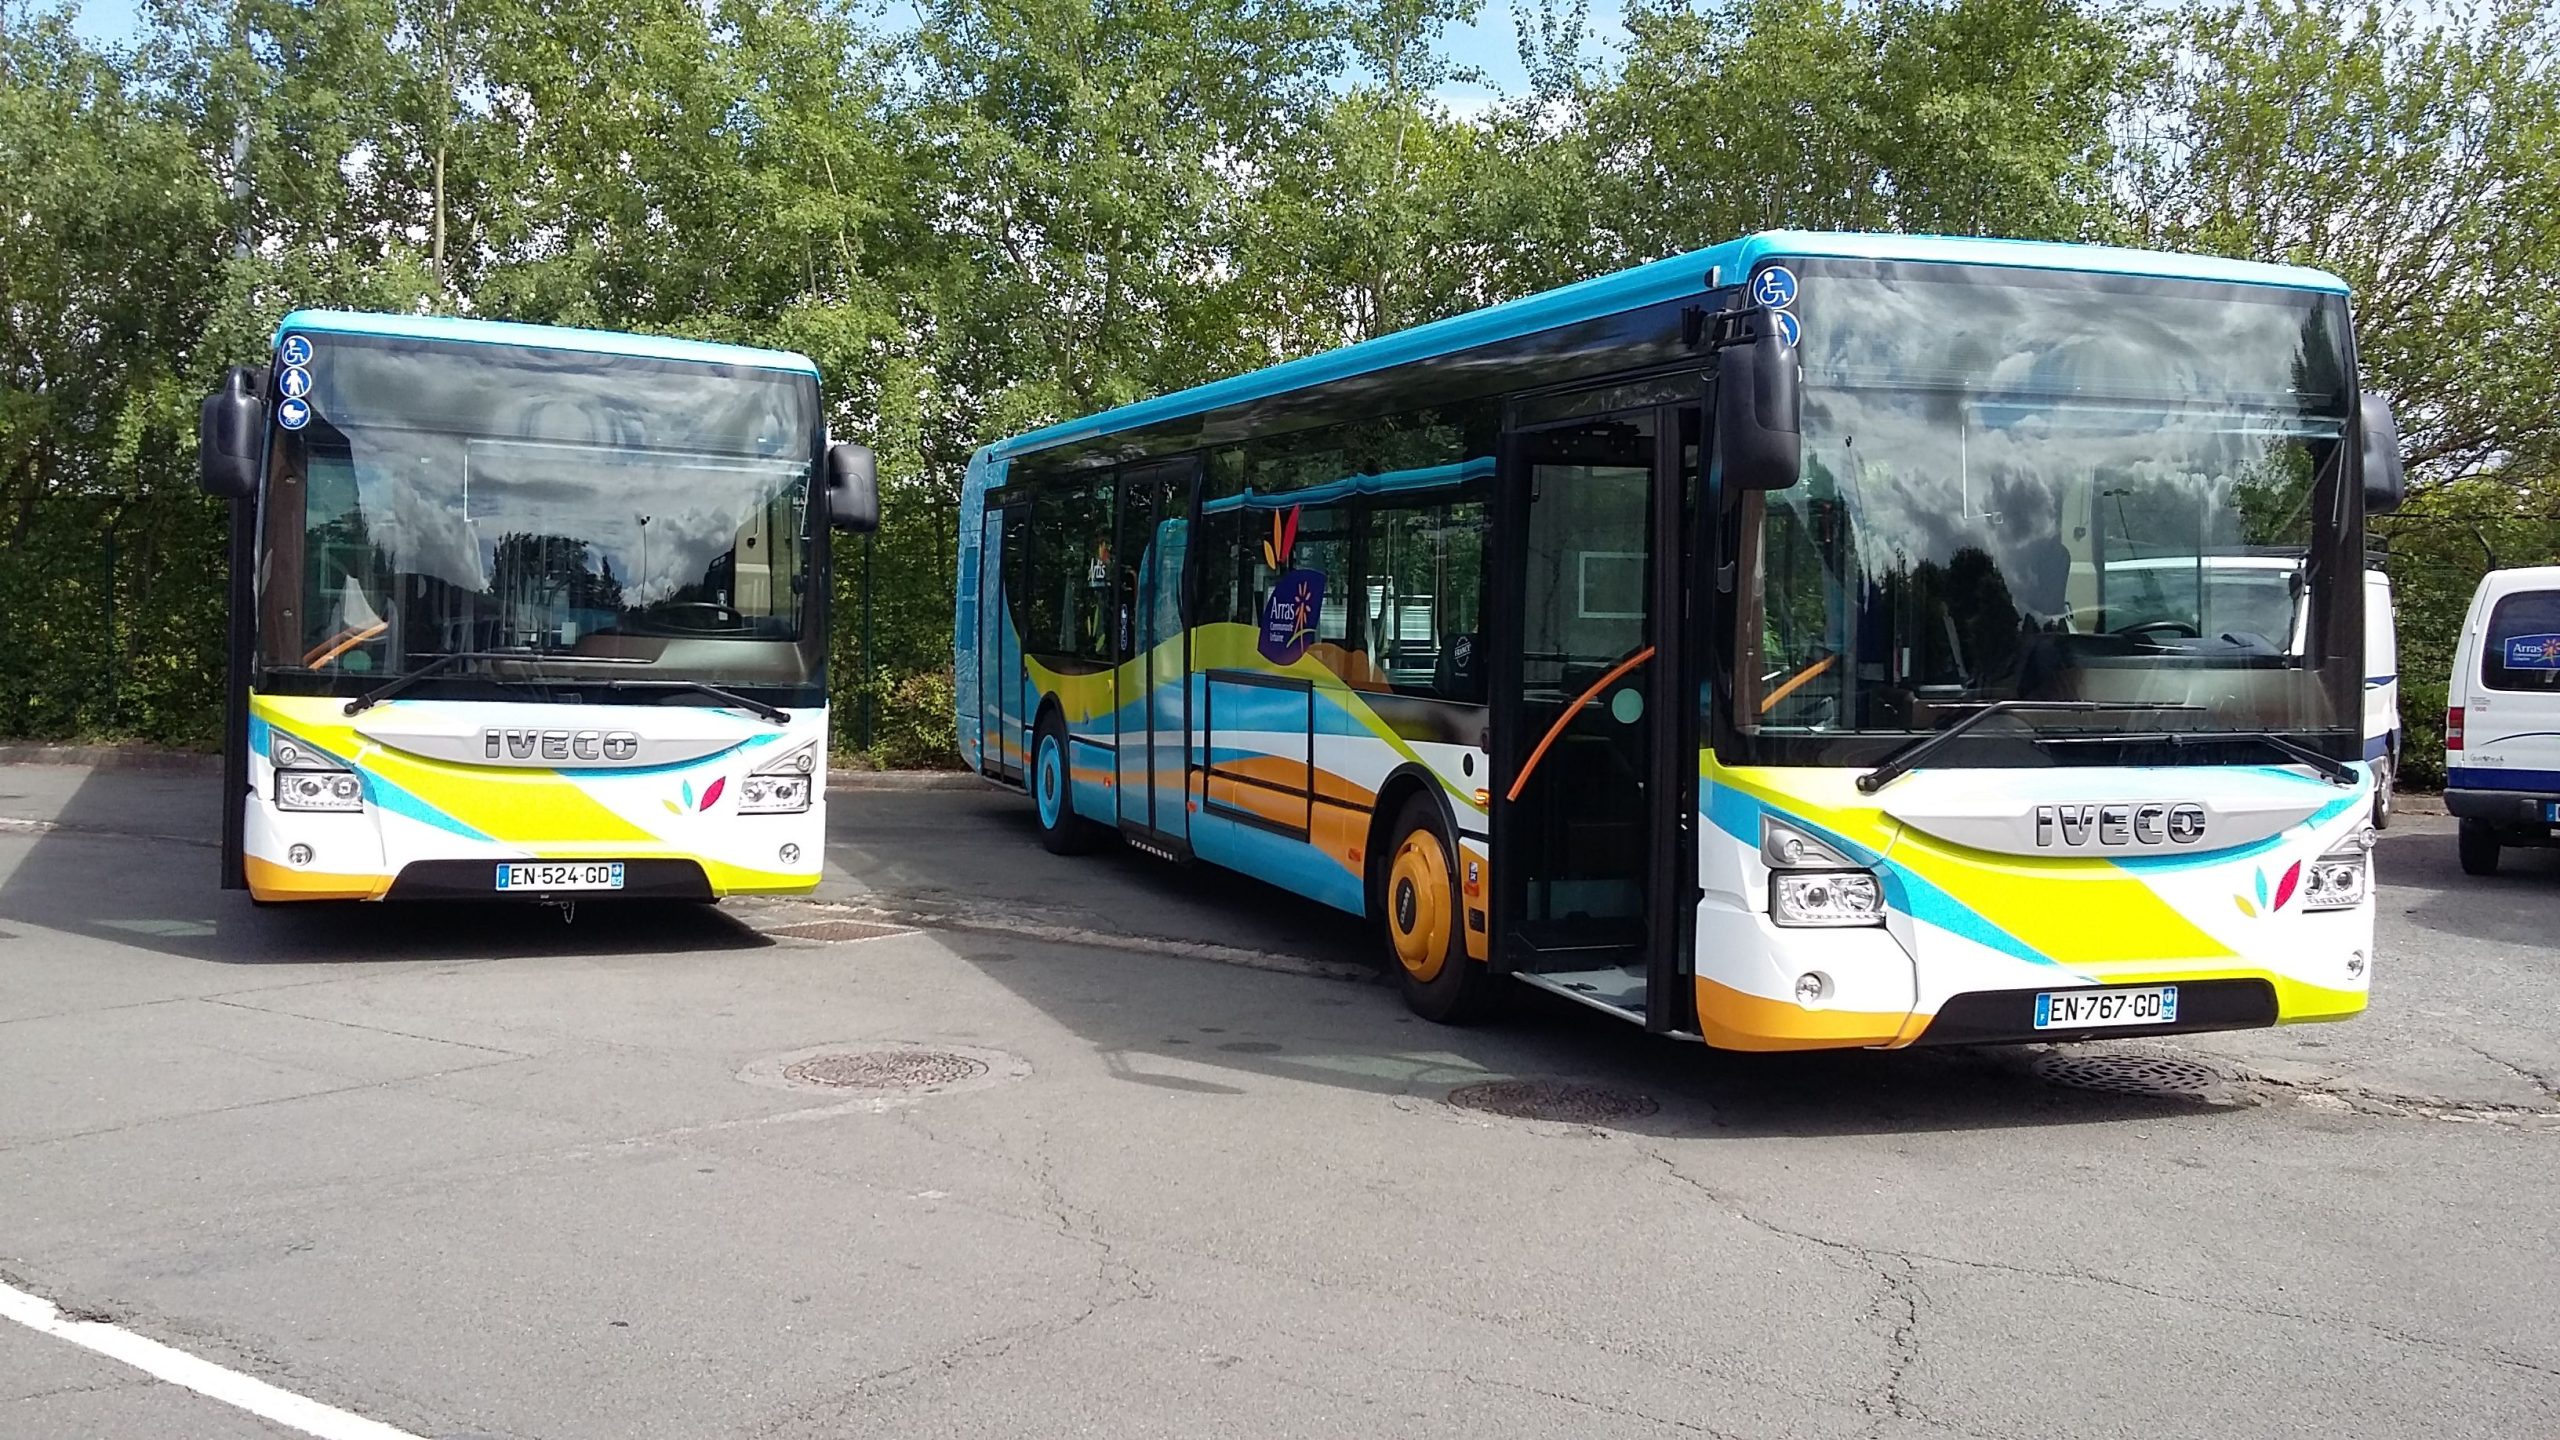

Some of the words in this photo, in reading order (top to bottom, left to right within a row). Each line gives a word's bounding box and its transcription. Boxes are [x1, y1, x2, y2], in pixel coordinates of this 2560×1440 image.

[1270, 596, 1295, 620] Arras
[2513, 643, 2543, 653] Arras
[486, 729, 638, 760] IVECO
[2036, 803, 2206, 847] IVECO
[511, 866, 609, 885] EN-524-GD
[2050, 993, 2161, 1022] EN-767-GD
